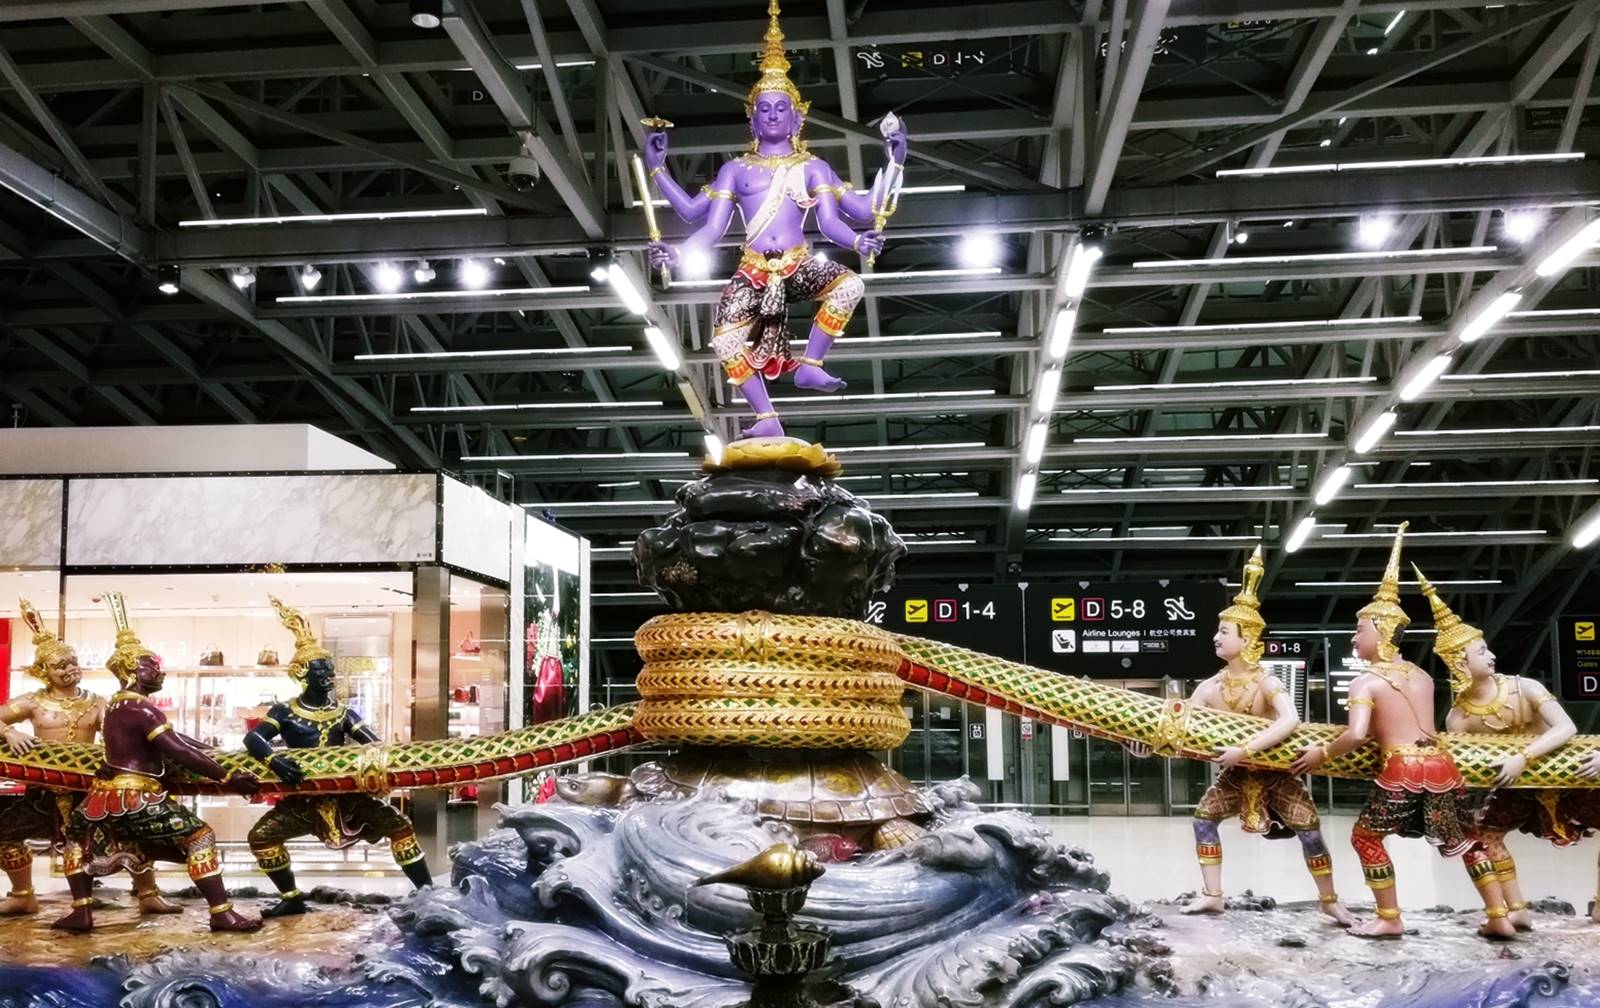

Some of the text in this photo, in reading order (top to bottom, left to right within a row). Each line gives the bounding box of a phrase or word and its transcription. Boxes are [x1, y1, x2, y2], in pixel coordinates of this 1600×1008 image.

[939, 601, 996, 620] D 1-4
[1086, 599, 1146, 619] D 5-8
[1082, 629, 1141, 639] Airline Lounges
[1269, 642, 1301, 653] D 1-8
[1583, 675, 1598, 693] D
